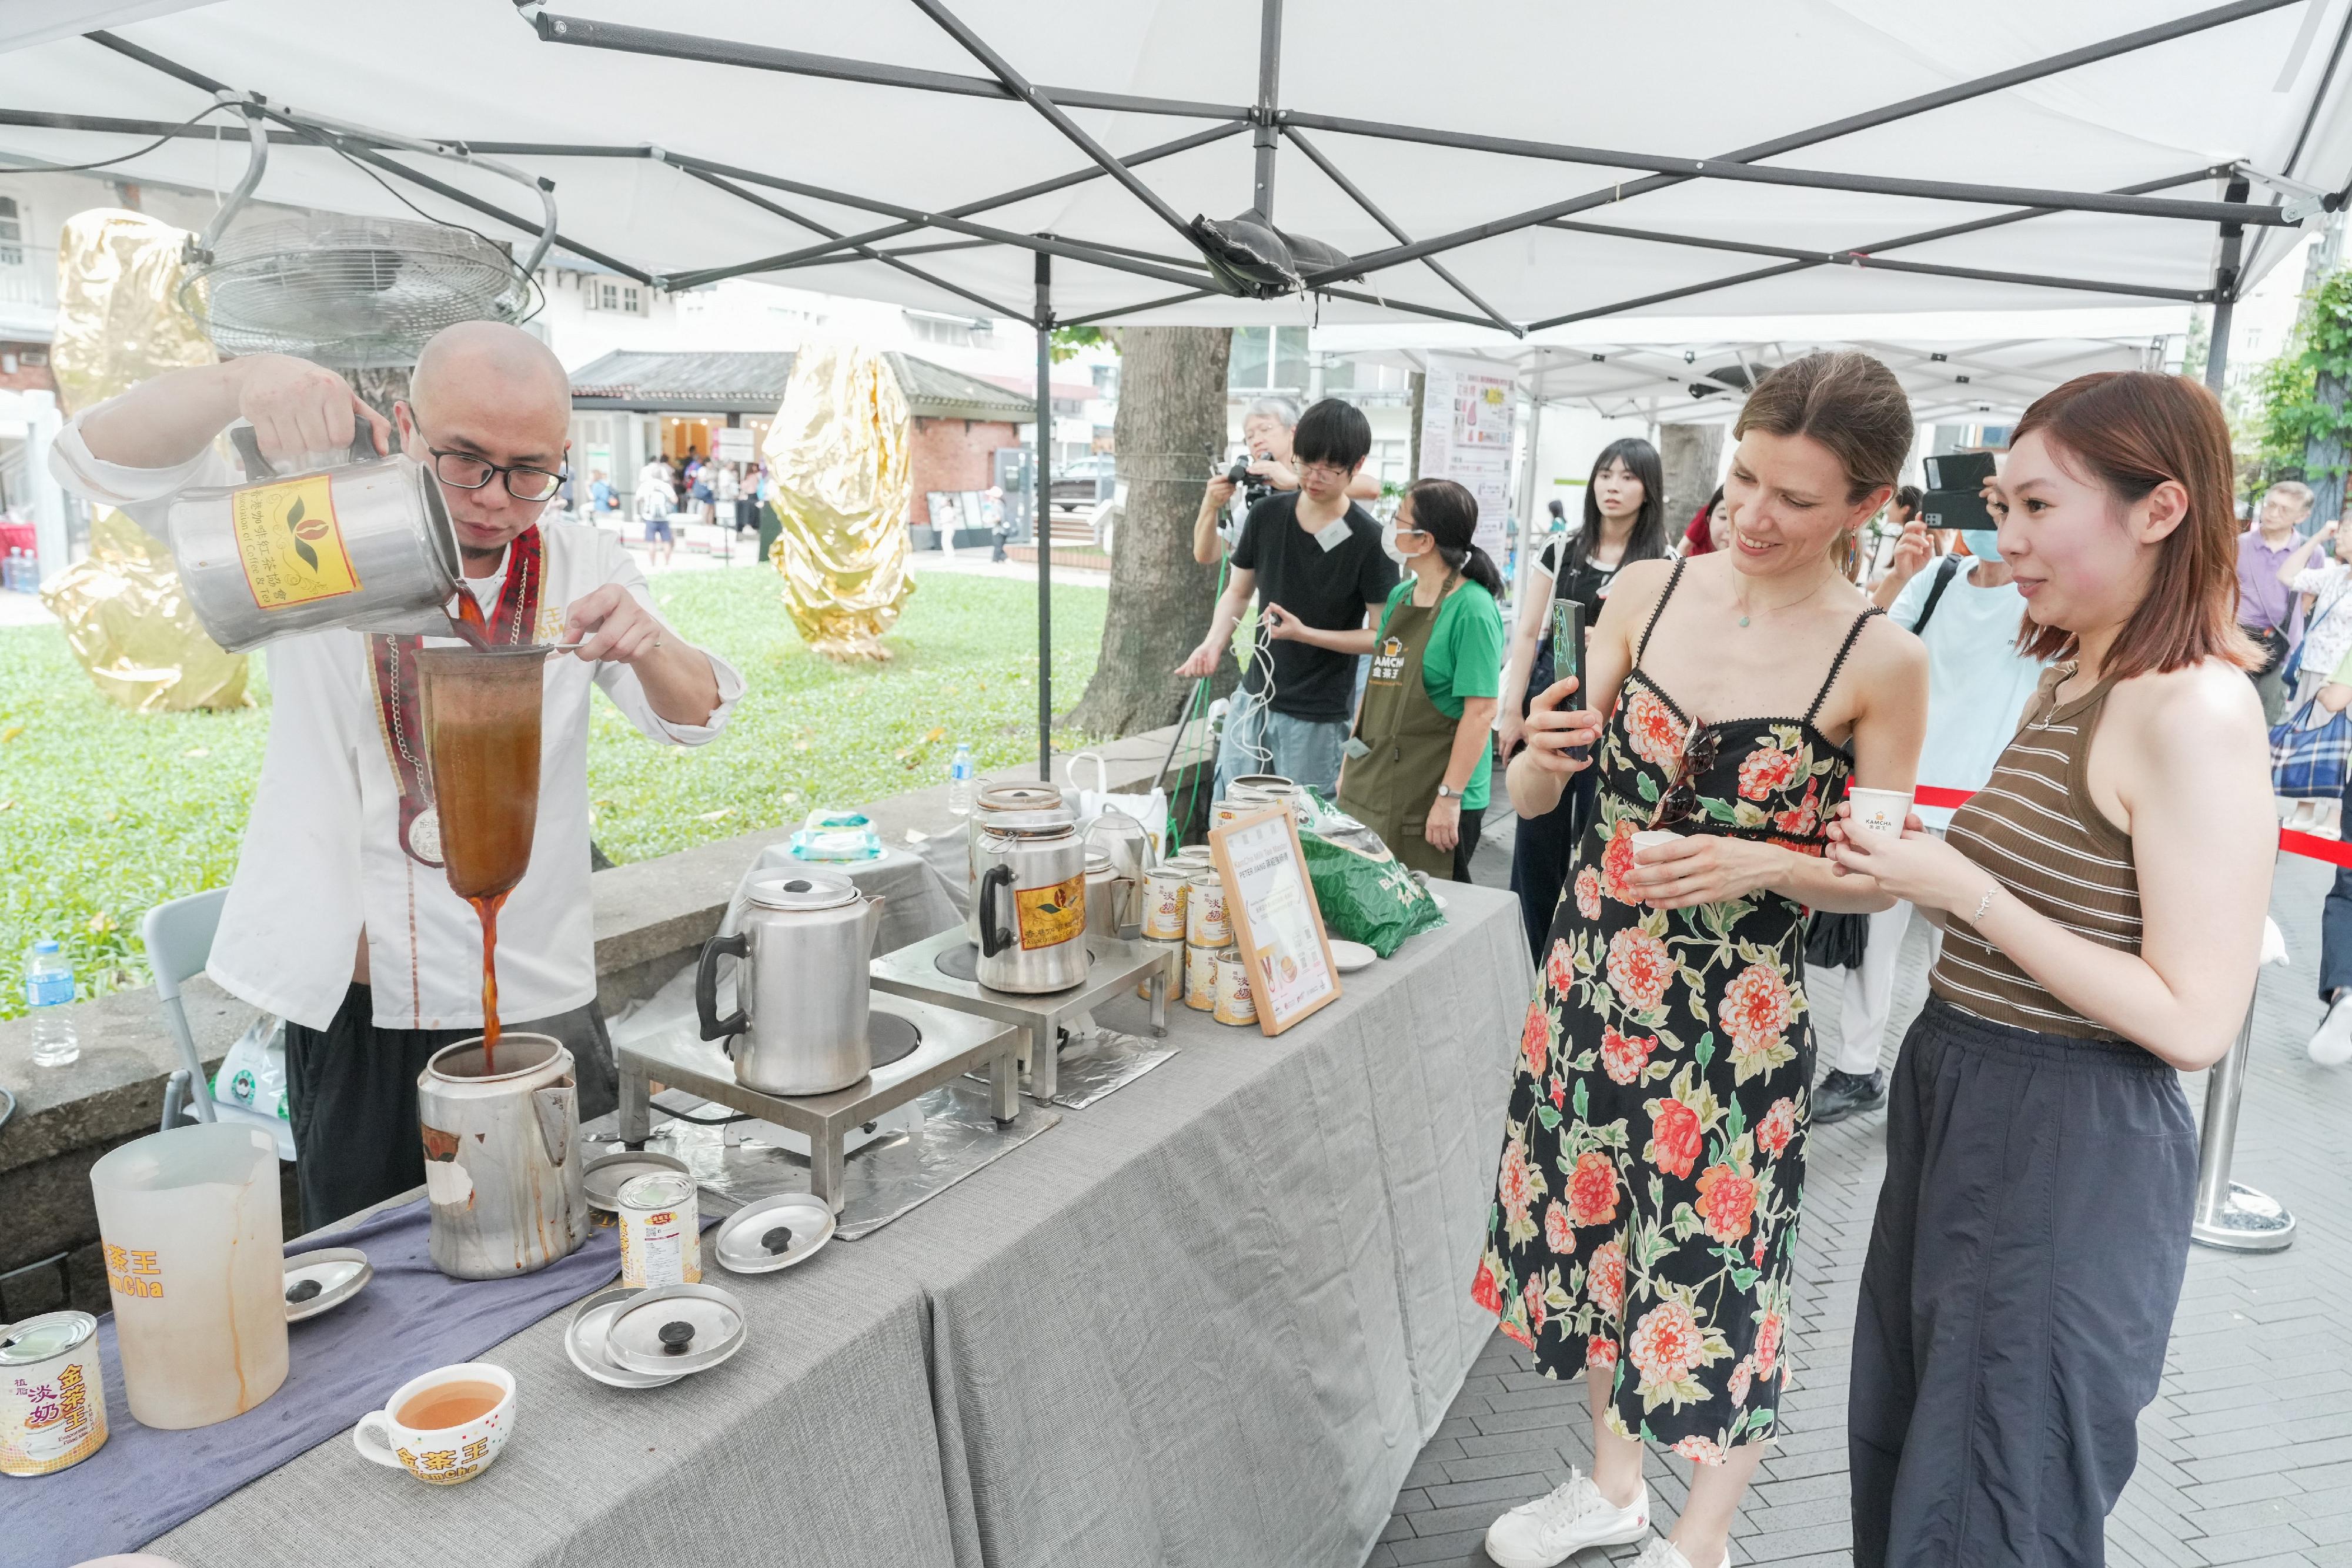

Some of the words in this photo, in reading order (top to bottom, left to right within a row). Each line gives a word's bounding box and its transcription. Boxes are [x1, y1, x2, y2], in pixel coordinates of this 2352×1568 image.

[239, 492, 249, 530] Association
[243, 533, 250, 541] of
[250, 489, 288, 600] 香港咖啡紅茶協會
[246, 545, 259, 574] Coffee
[255, 577, 265, 586] &
[260, 588, 270, 603] Tea
[1239, 867, 1254, 880] PETER
[1162, 891, 1175, 912] 淡奶
[1208, 898, 1221, 919] 淡奶
[1237, 977, 1250, 998] 淡奶
[14, 1378, 29, 1396] 植脂
[28, 1383, 59, 1424] 淡奶
[57, 1363, 88, 1433] 金茶王
[396, 1436, 489, 1470] 金茶王
